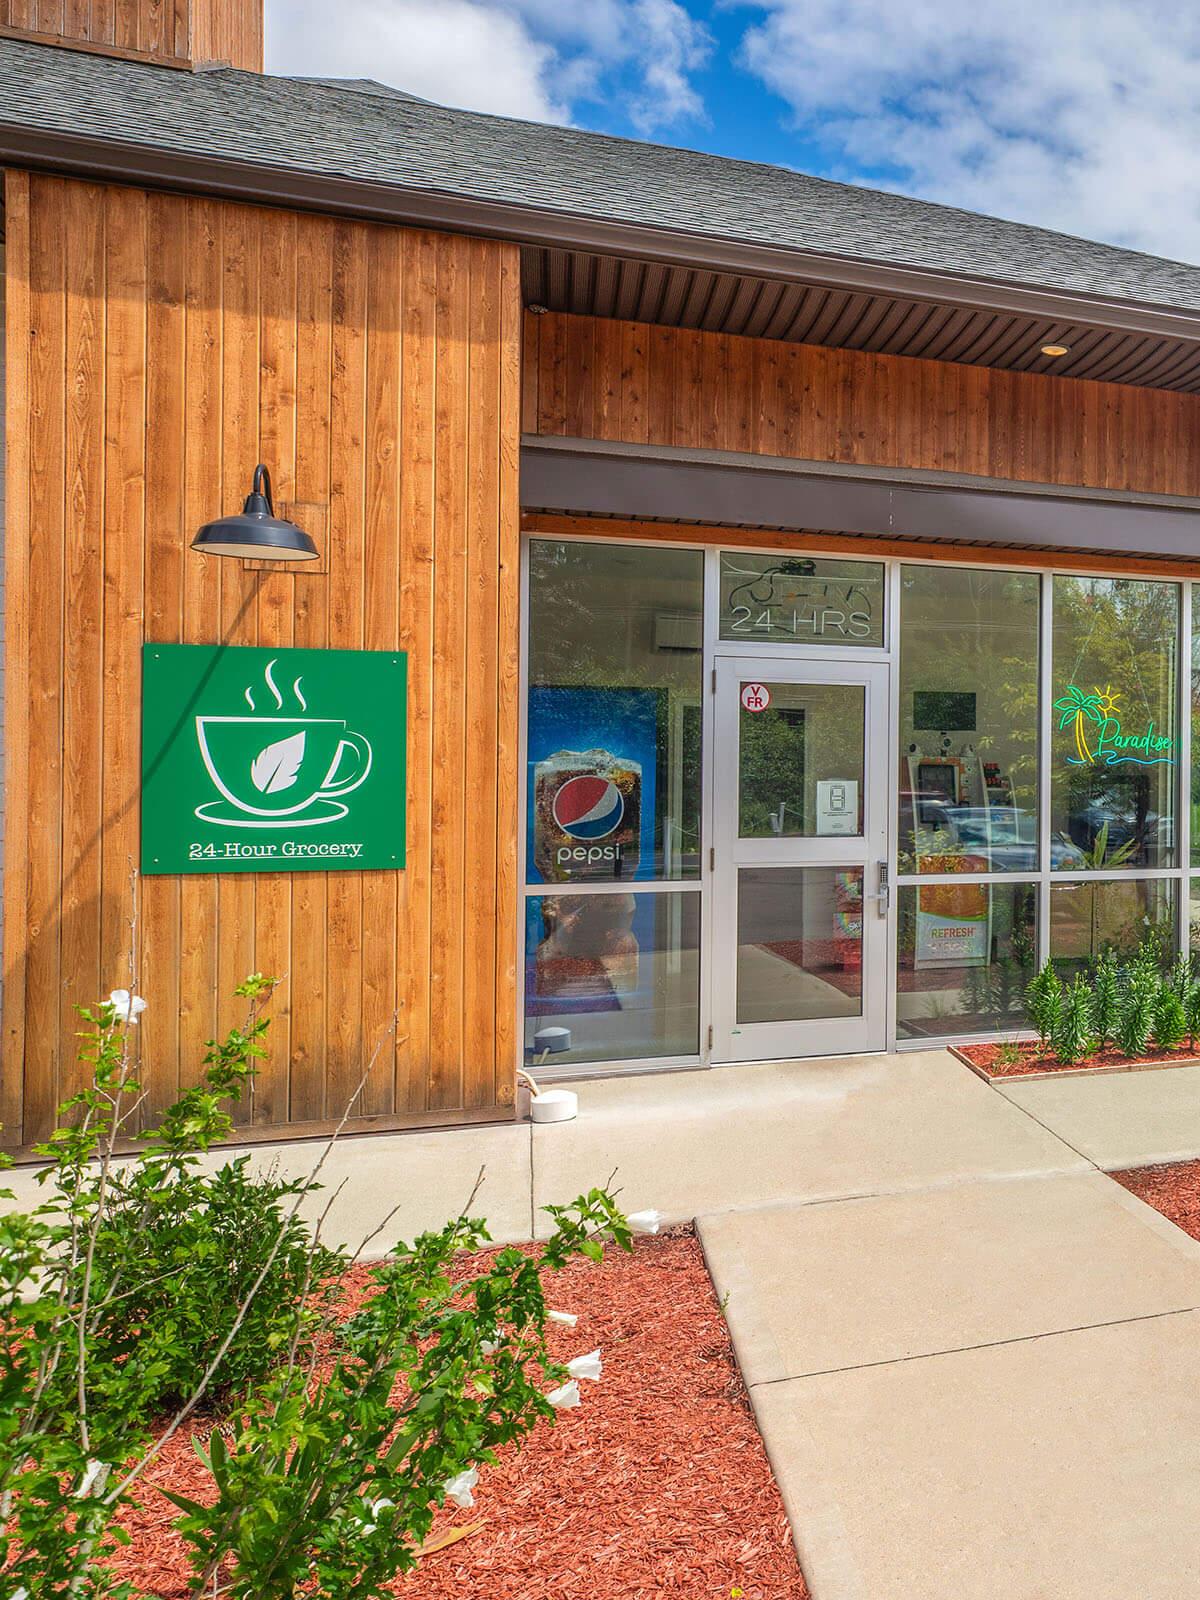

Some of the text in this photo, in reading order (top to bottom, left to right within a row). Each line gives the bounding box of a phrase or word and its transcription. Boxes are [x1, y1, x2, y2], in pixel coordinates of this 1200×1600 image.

[731, 605, 871, 637] 24 HRS
[750, 686, 761, 697] V
[747, 697, 763, 708] FR
[1098, 717, 1173, 757] Paradise
[189, 841, 363, 859] 24-Hour Grocery
[557, 843, 620, 865] pepsi
[931, 927, 975, 939] REFRESH
